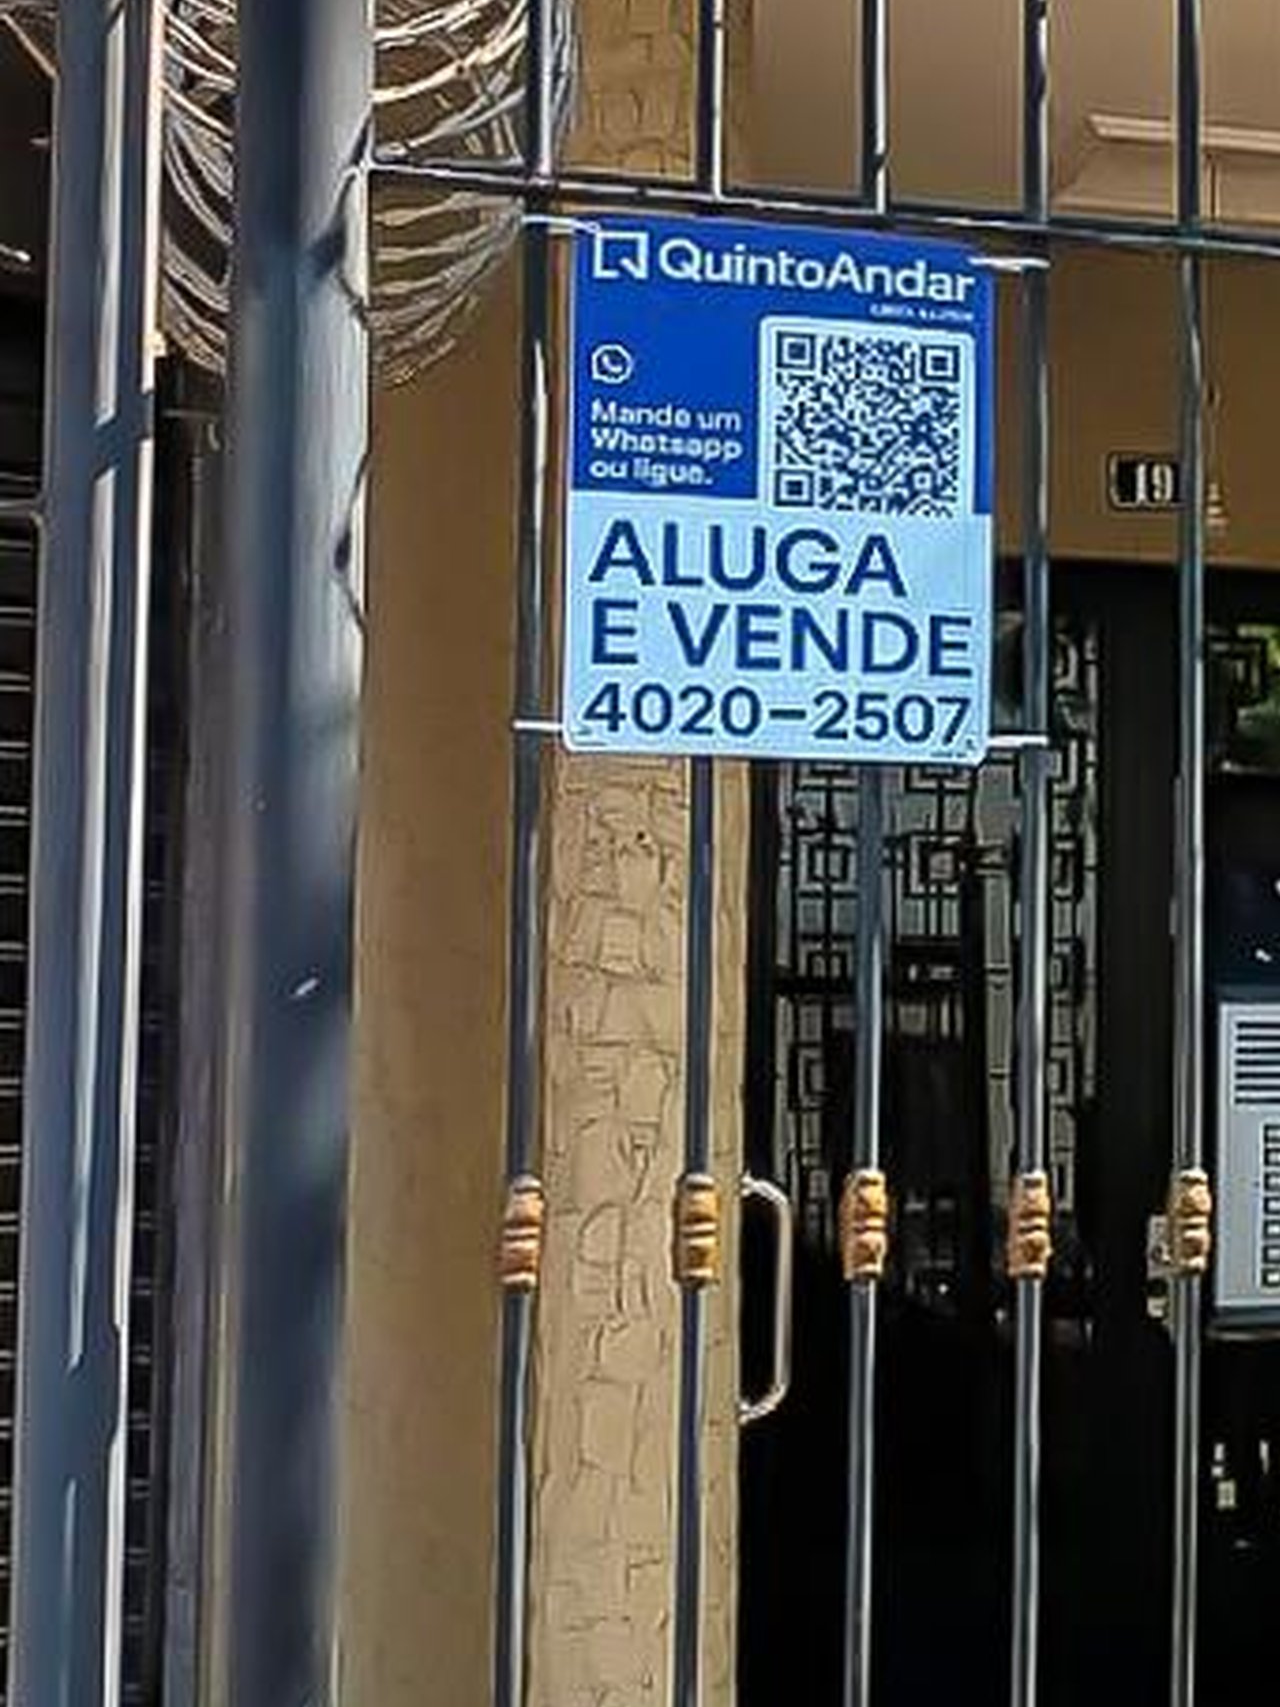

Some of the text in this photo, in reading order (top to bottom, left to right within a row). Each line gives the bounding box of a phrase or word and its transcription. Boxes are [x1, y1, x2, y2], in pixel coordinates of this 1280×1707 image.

[658, 238, 975, 302] QuintoAndar
[591, 398, 742, 432] Mande um
[589, 457, 714, 487] ou ligue.
[588, 519, 907, 597] ALUGA
[591, 598, 973, 678] E VENDE
[582, 682, 972, 747] 4020-2507
